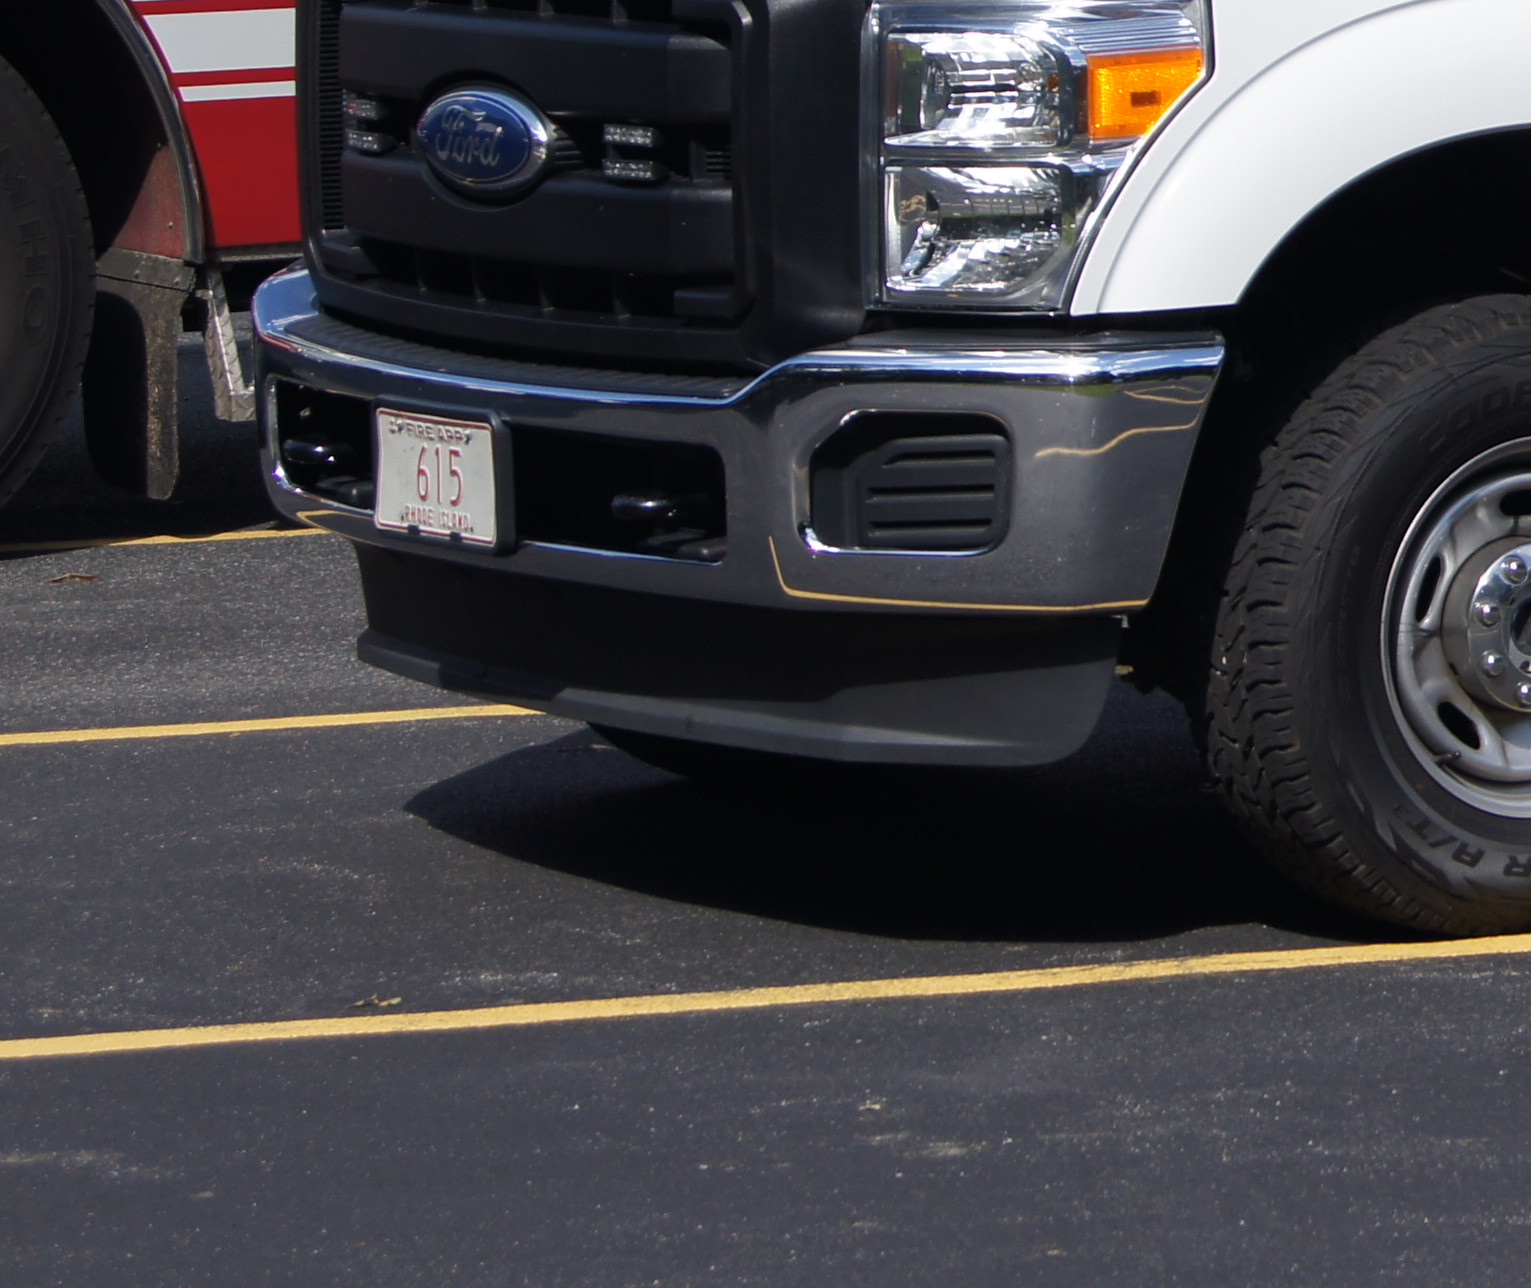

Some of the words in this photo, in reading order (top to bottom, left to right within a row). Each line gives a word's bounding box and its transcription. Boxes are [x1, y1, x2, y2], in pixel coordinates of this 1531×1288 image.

[435, 104, 503, 166] Ford
[405, 422, 435, 441] FIRE
[417, 443, 463, 506] 615
[404, 504, 434, 527] RHODE
[438, 510, 471, 533] ISLAND
